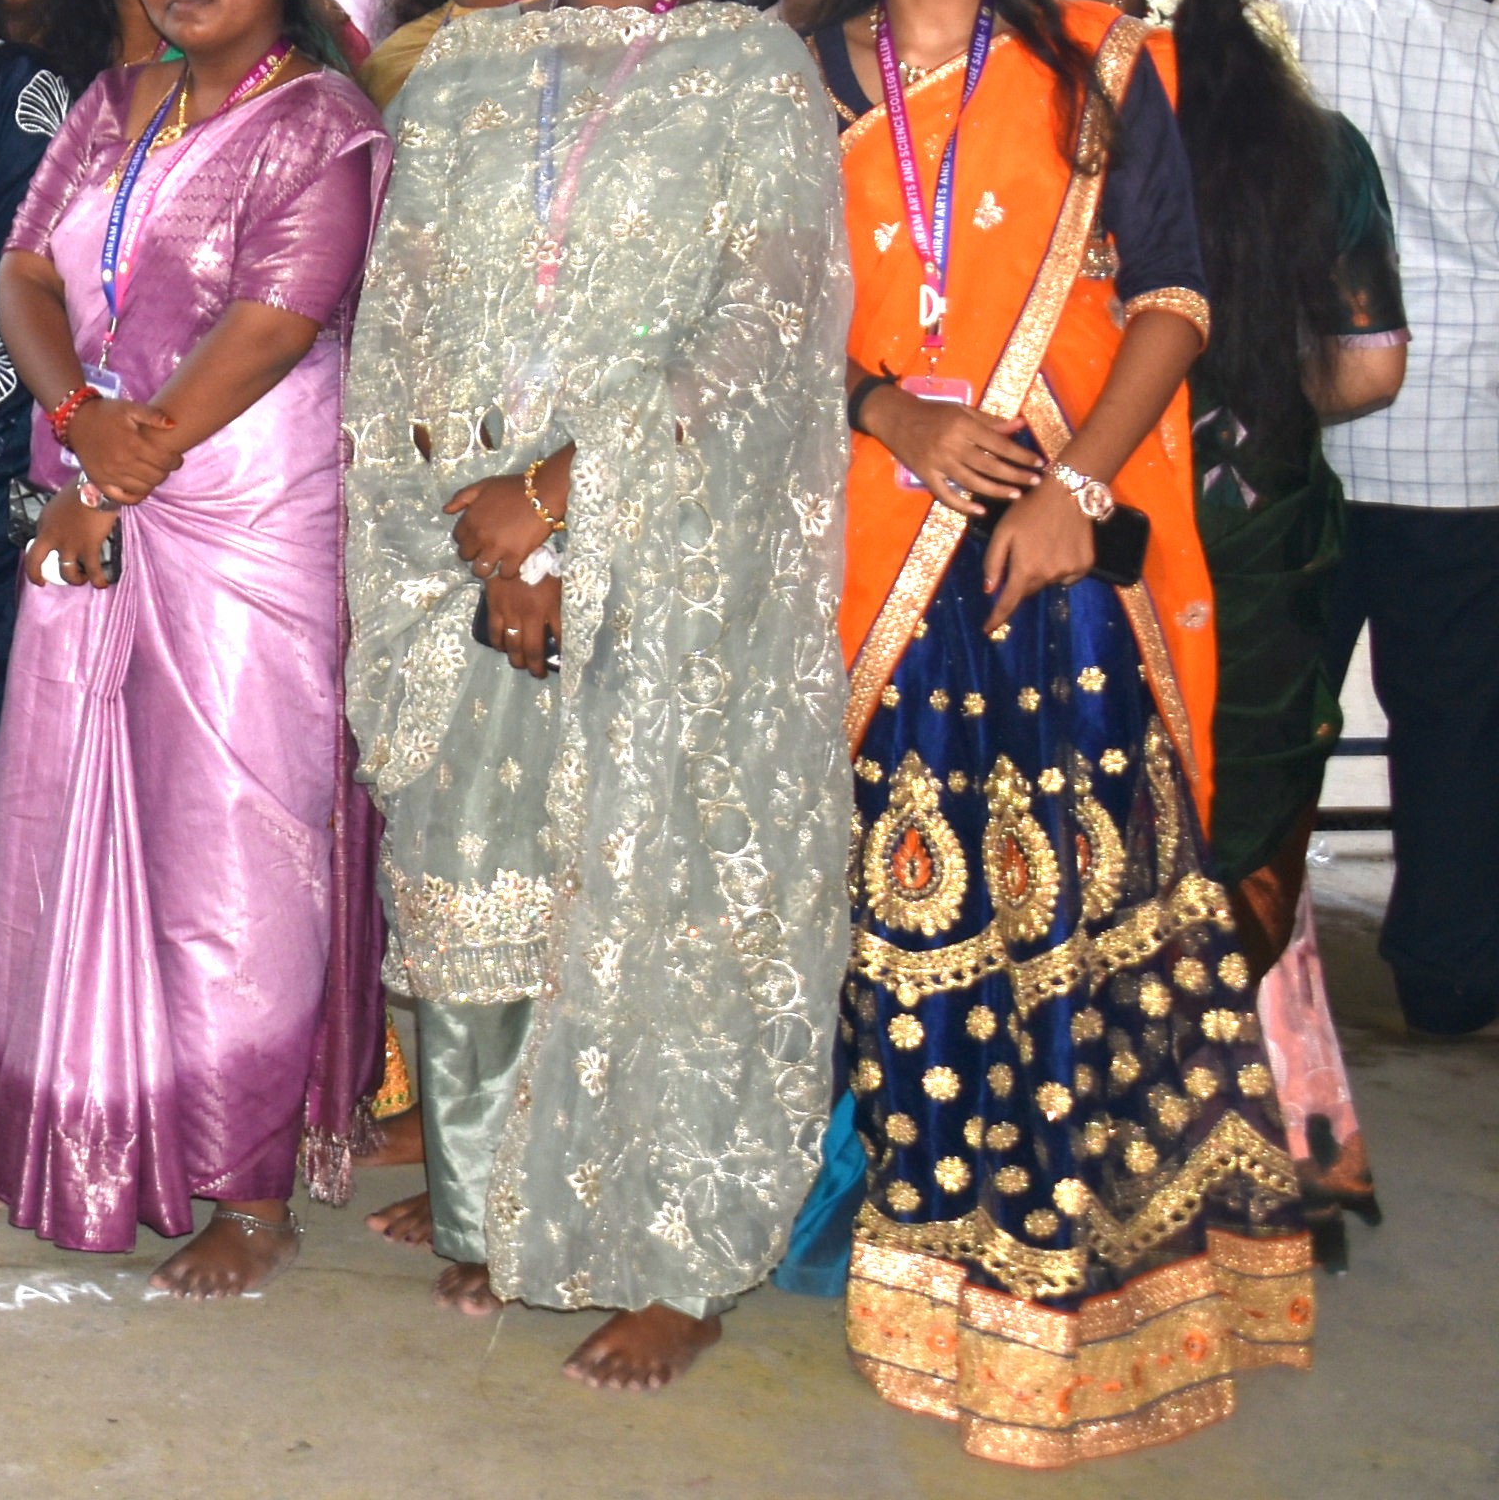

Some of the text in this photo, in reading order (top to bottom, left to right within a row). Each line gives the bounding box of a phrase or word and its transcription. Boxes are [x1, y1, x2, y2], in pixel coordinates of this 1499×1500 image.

[879, 37, 893, 69] SALEM
[971, 34, 985, 65] SALEM
[978, 18, 988, 26] 8
[259, 64, 267, 74] 8
[885, 71, 901, 113] COLLEGE
[893, 115, 909, 157] SCIENCE
[901, 159, 914, 182] AND
[939, 160, 950, 185] AND
[905, 184, 919, 211] ARTS
[935, 187, 947, 217] ARTS
[104, 225, 117, 264] JAIRAM
[111, 198, 123, 223] ARTS
[118, 178, 131, 197] AND
[123, 216, 140, 257] JAIRAM
[912, 214, 931, 256] JAIRAM
[933, 219, 944, 264] JAIRAM
